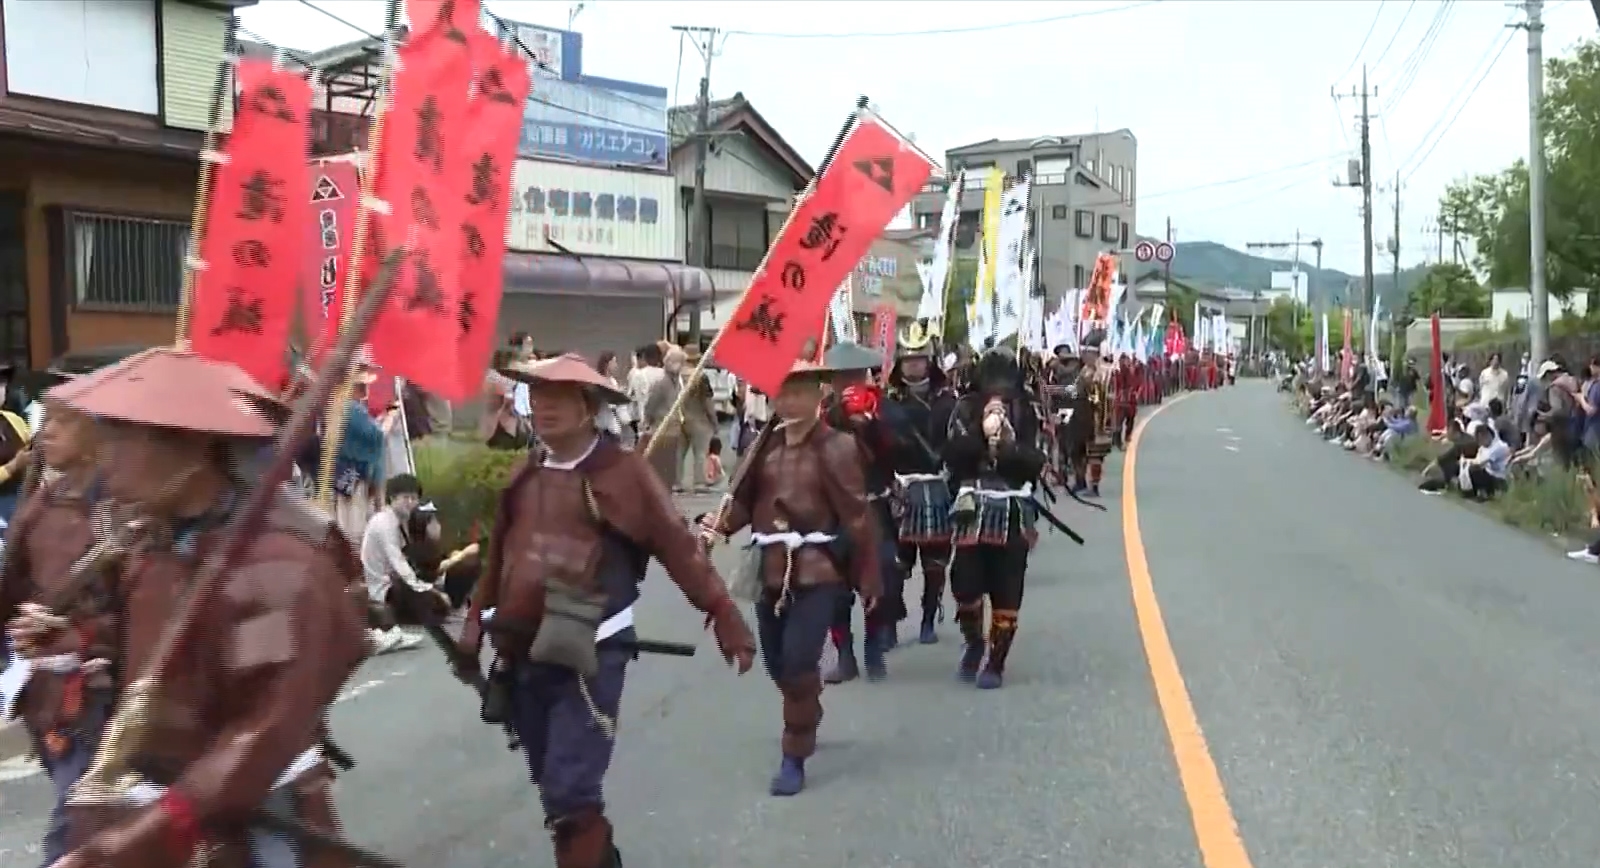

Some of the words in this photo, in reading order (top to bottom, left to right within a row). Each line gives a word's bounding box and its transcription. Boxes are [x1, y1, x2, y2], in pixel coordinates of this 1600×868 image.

[580, 130, 656, 155] ガスエアコン
